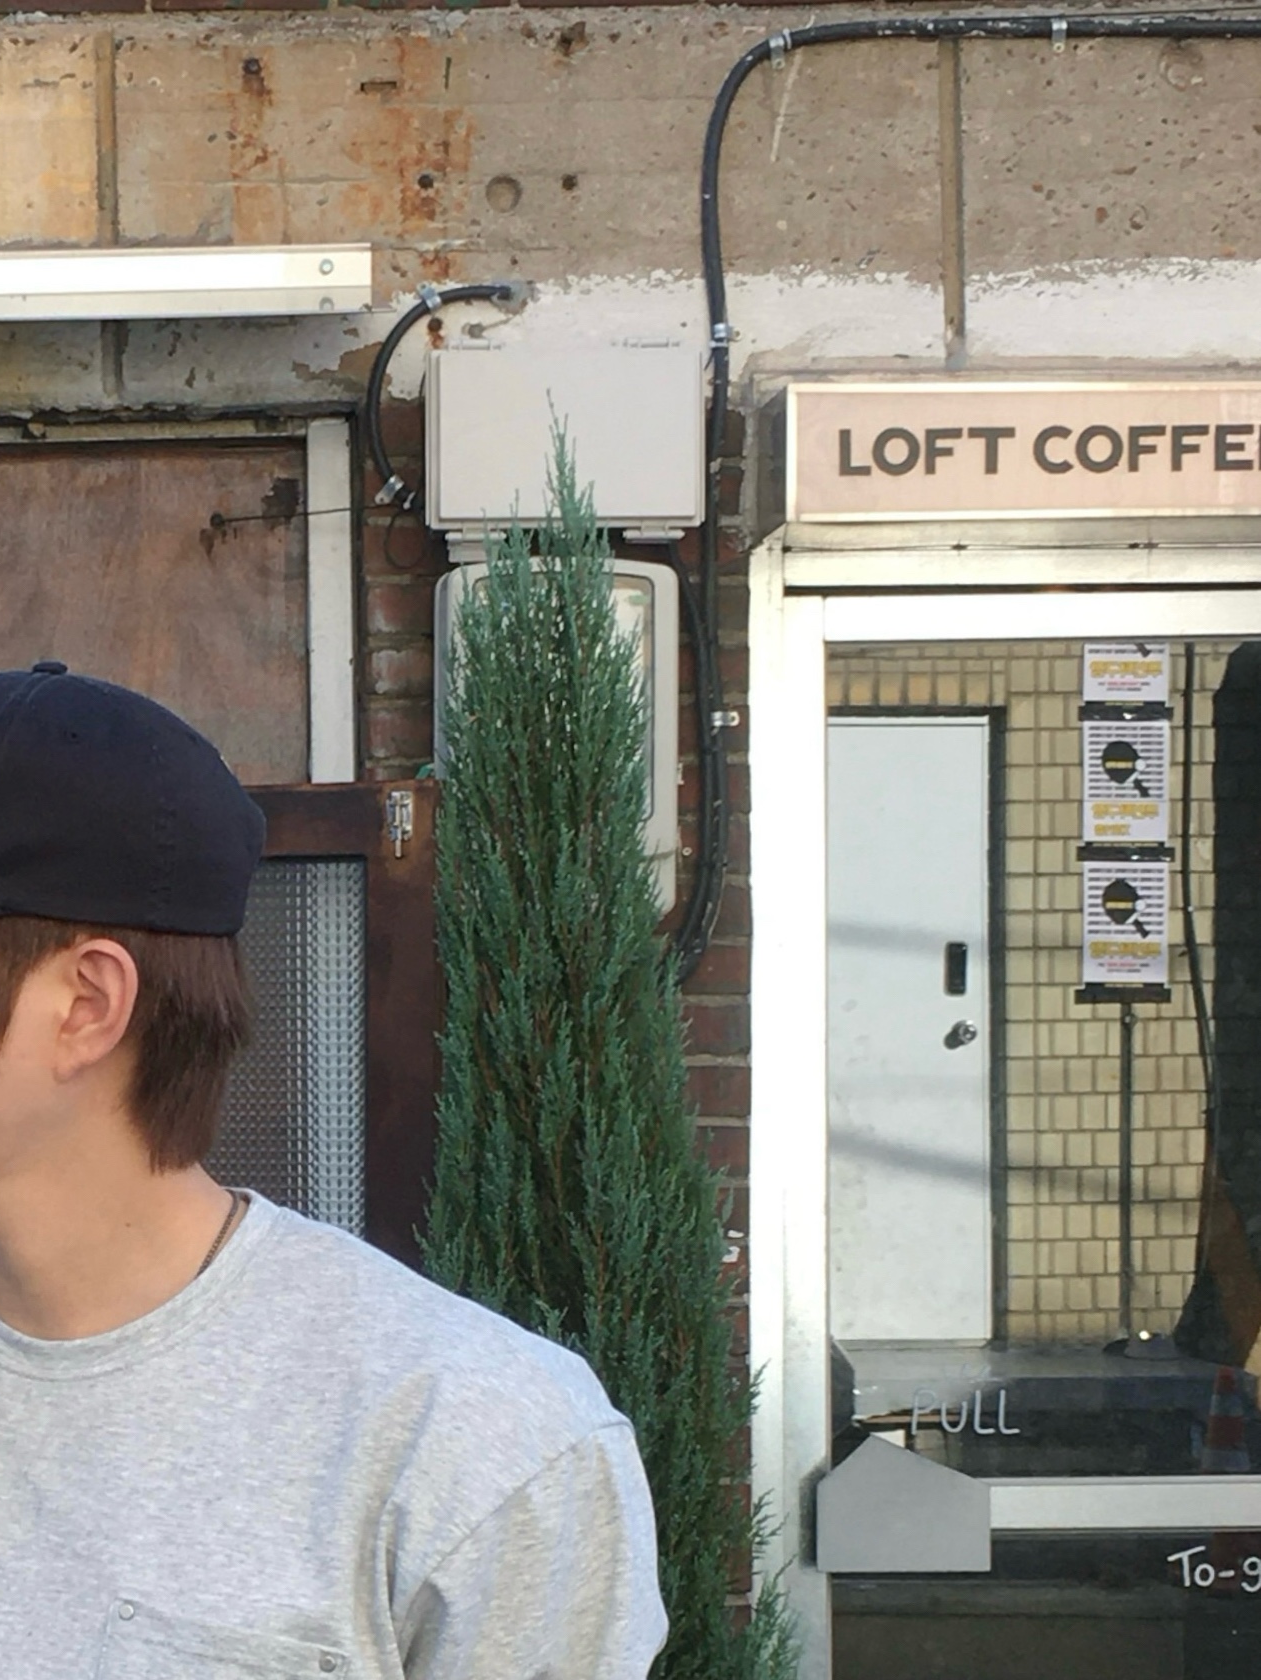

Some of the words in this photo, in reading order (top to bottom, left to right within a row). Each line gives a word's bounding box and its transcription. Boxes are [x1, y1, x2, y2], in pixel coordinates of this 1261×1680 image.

[838, 426, 1016, 476] LOFT
[1032, 424, 1261, 475] COFFE
[910, 1386, 1021, 1436] PULL
